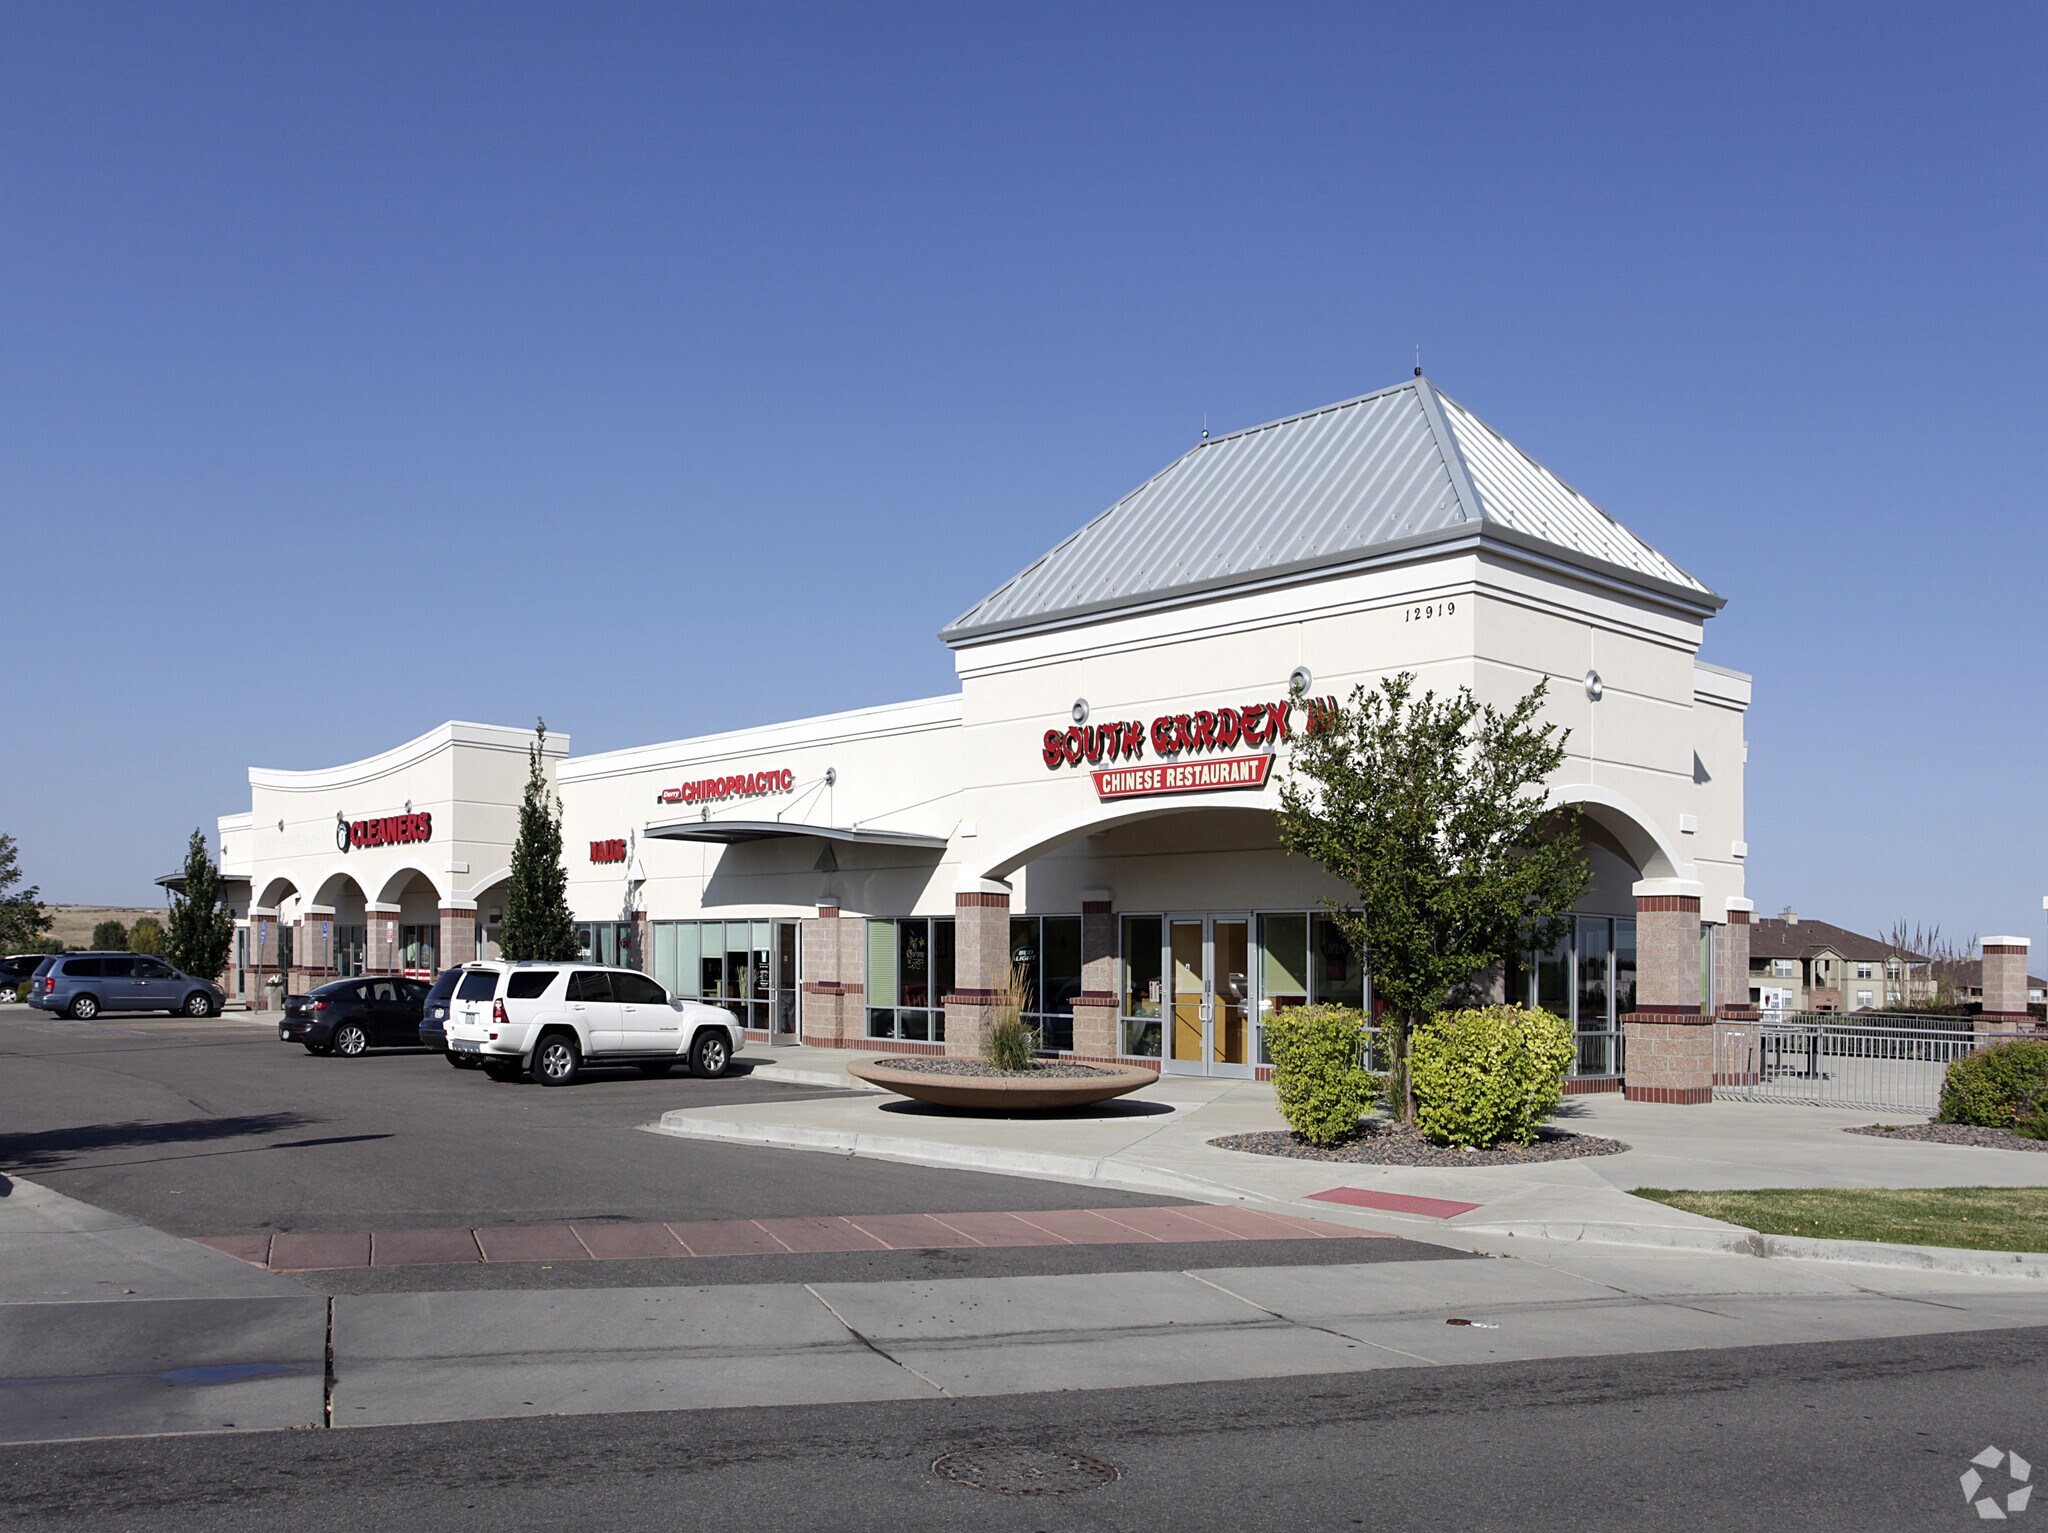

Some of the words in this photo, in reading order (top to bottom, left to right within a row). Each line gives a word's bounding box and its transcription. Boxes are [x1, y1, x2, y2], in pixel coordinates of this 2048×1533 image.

[1405, 602, 1455, 622] 12919
[1042, 720, 1144, 768] SOUTH
[1151, 699, 1290, 754] GARDEN
[682, 769, 793, 802] CHIROPRACTIC
[1102, 769, 1161, 793] CHINESE
[1166, 760, 1259, 787] RESTAURANT
[350, 812, 430, 847] CLEANERS
[590, 839, 625, 862] NAILS
